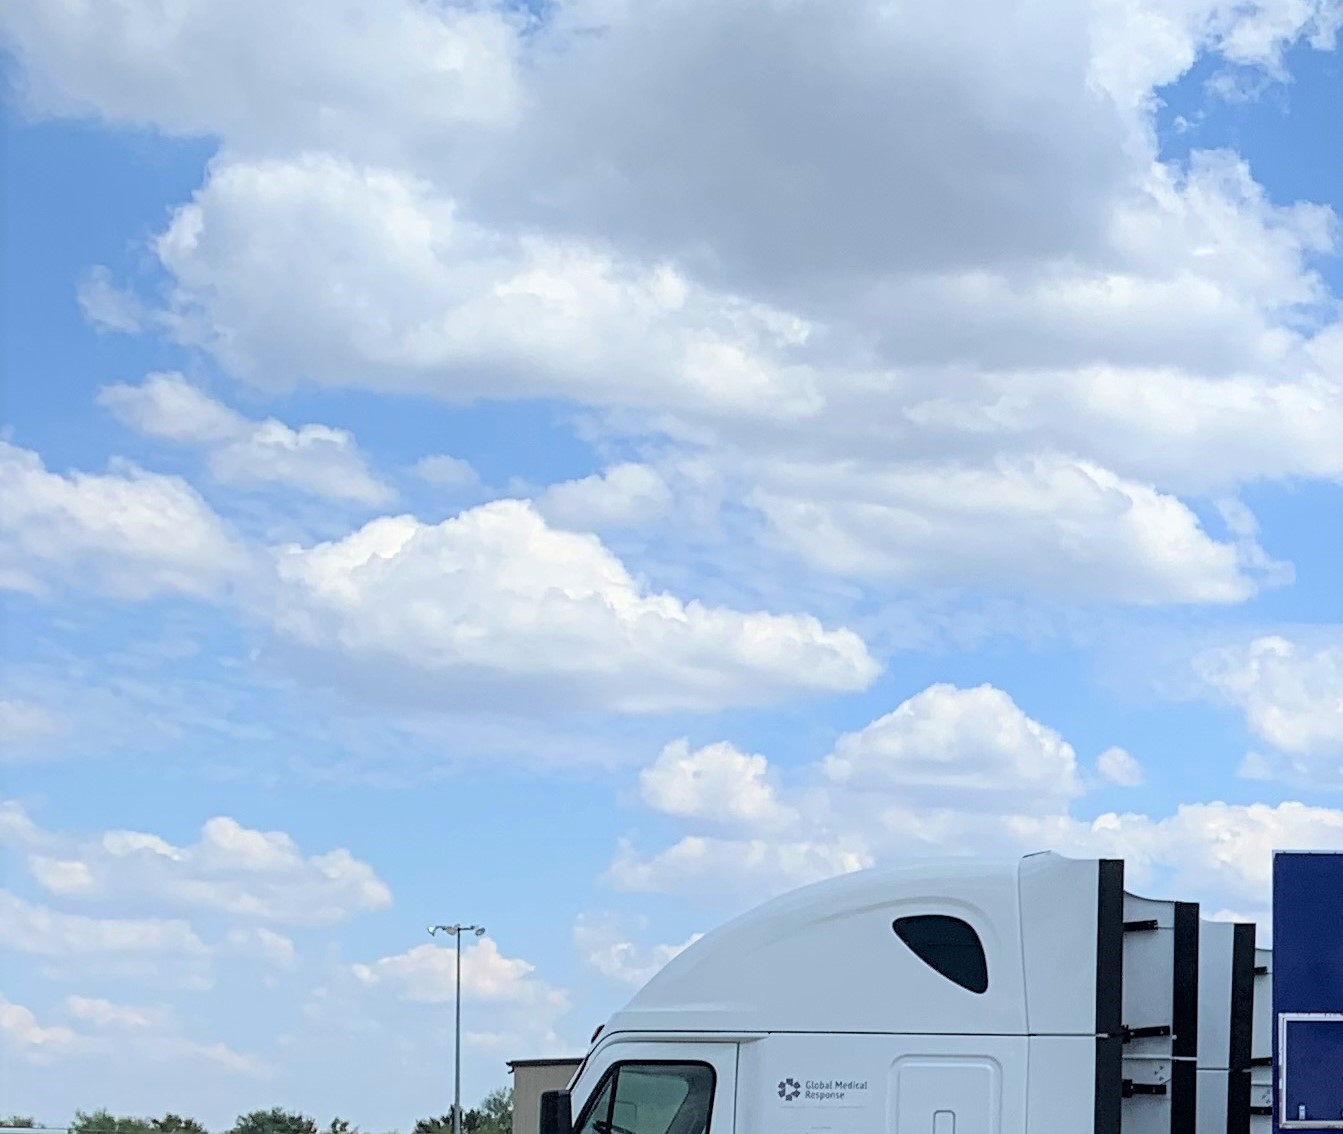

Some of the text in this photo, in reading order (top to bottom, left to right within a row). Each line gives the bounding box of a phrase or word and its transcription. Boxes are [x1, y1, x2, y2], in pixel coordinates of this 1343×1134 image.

[805, 1080, 868, 1090] Global Medical
[805, 1090, 845, 1101] Response
